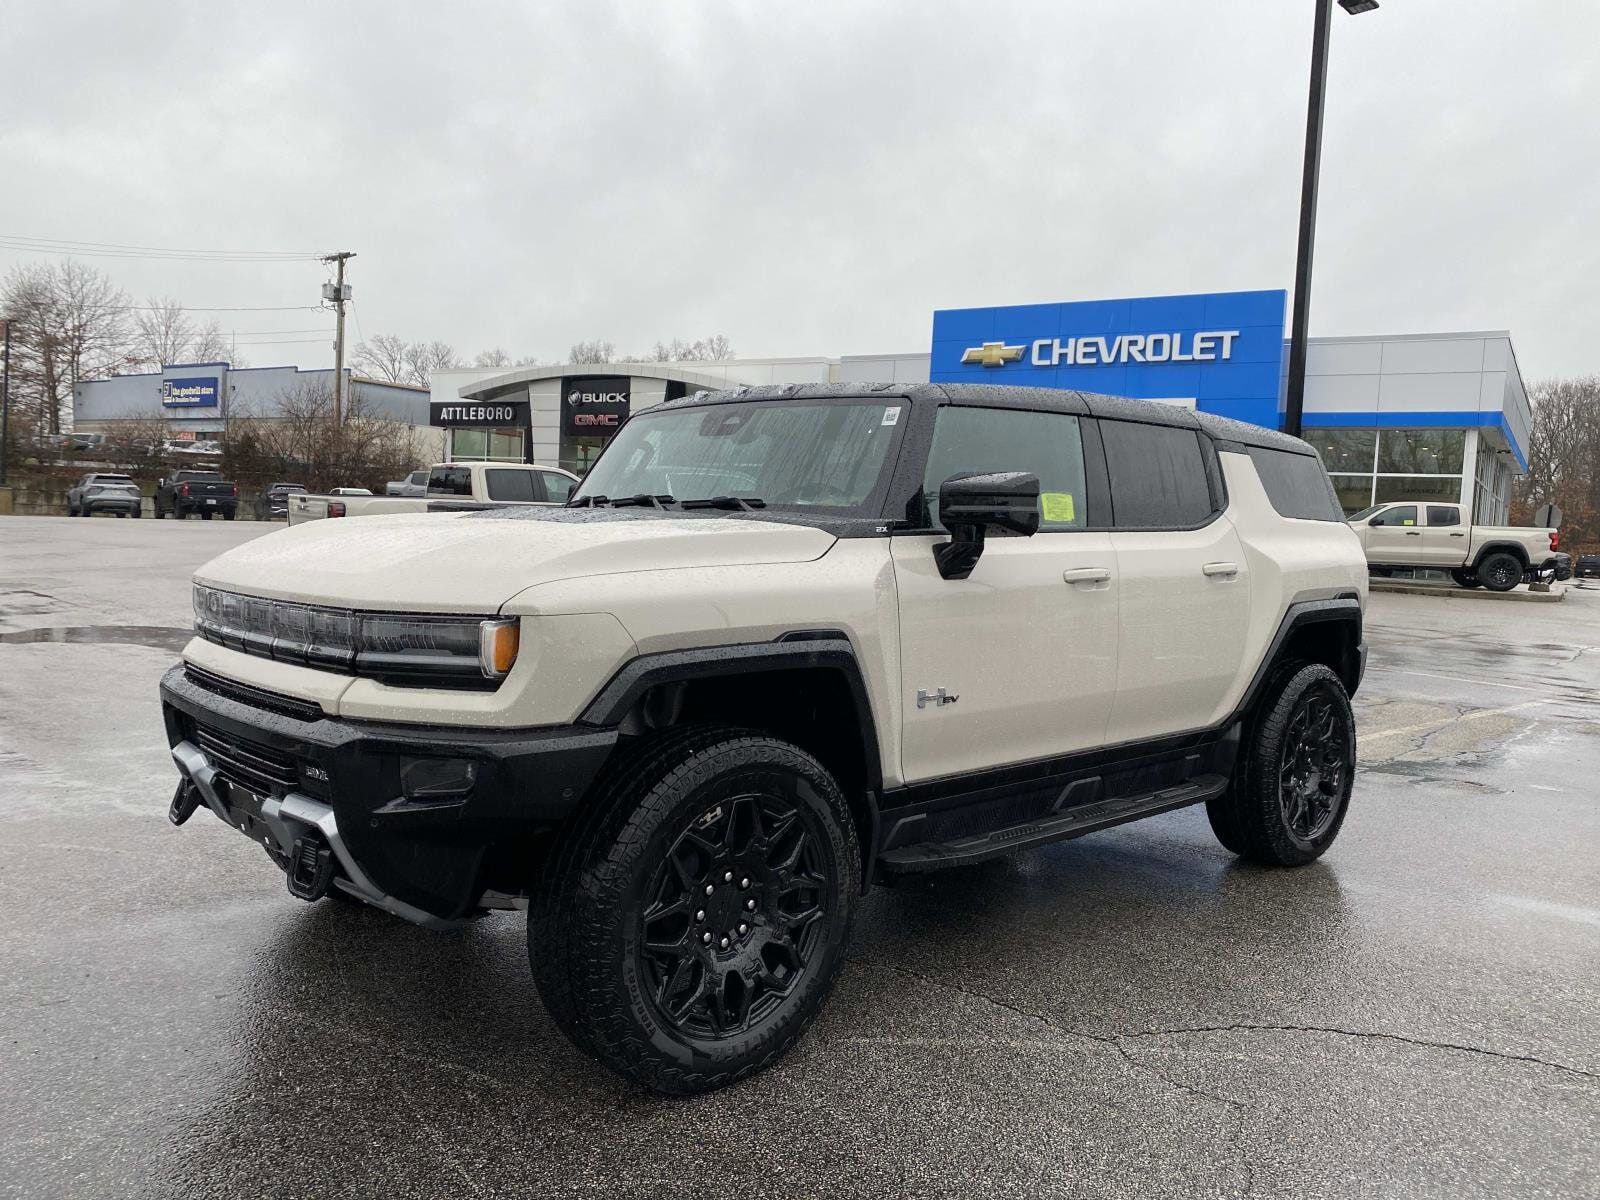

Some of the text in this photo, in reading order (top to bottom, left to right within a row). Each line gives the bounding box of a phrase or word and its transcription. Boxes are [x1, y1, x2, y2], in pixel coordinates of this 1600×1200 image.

[1031, 330, 1240, 366] CHEVROLET
[582, 392, 627, 403] BUICK
[440, 407, 512, 420] ATTLEBORO
[574, 414, 619, 426] GMC
